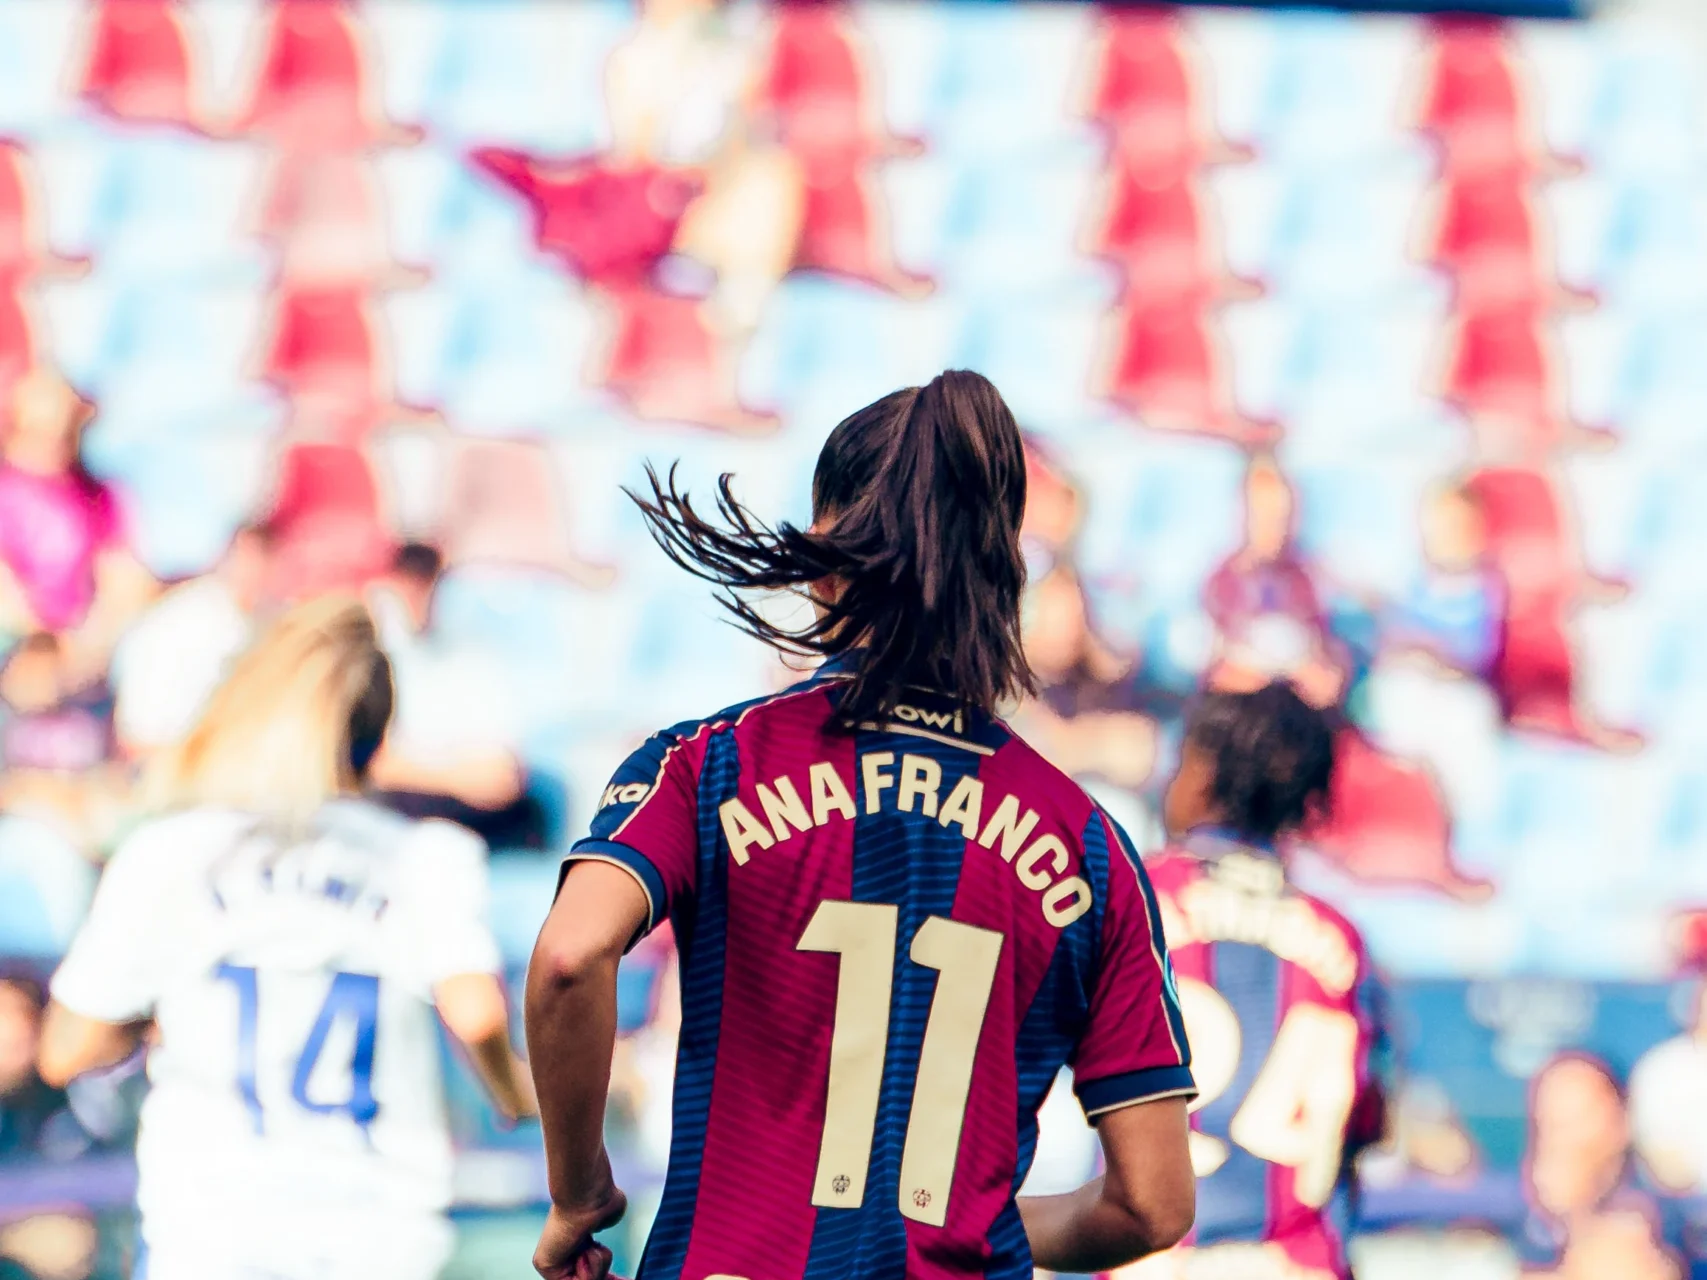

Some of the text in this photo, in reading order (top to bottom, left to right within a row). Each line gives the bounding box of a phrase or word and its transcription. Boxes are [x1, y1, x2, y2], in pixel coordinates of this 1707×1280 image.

[879, 701, 963, 734] owi
[597, 782, 651, 813] ka
[212, 961, 382, 1143] 14
[795, 898, 1005, 1228] 11
